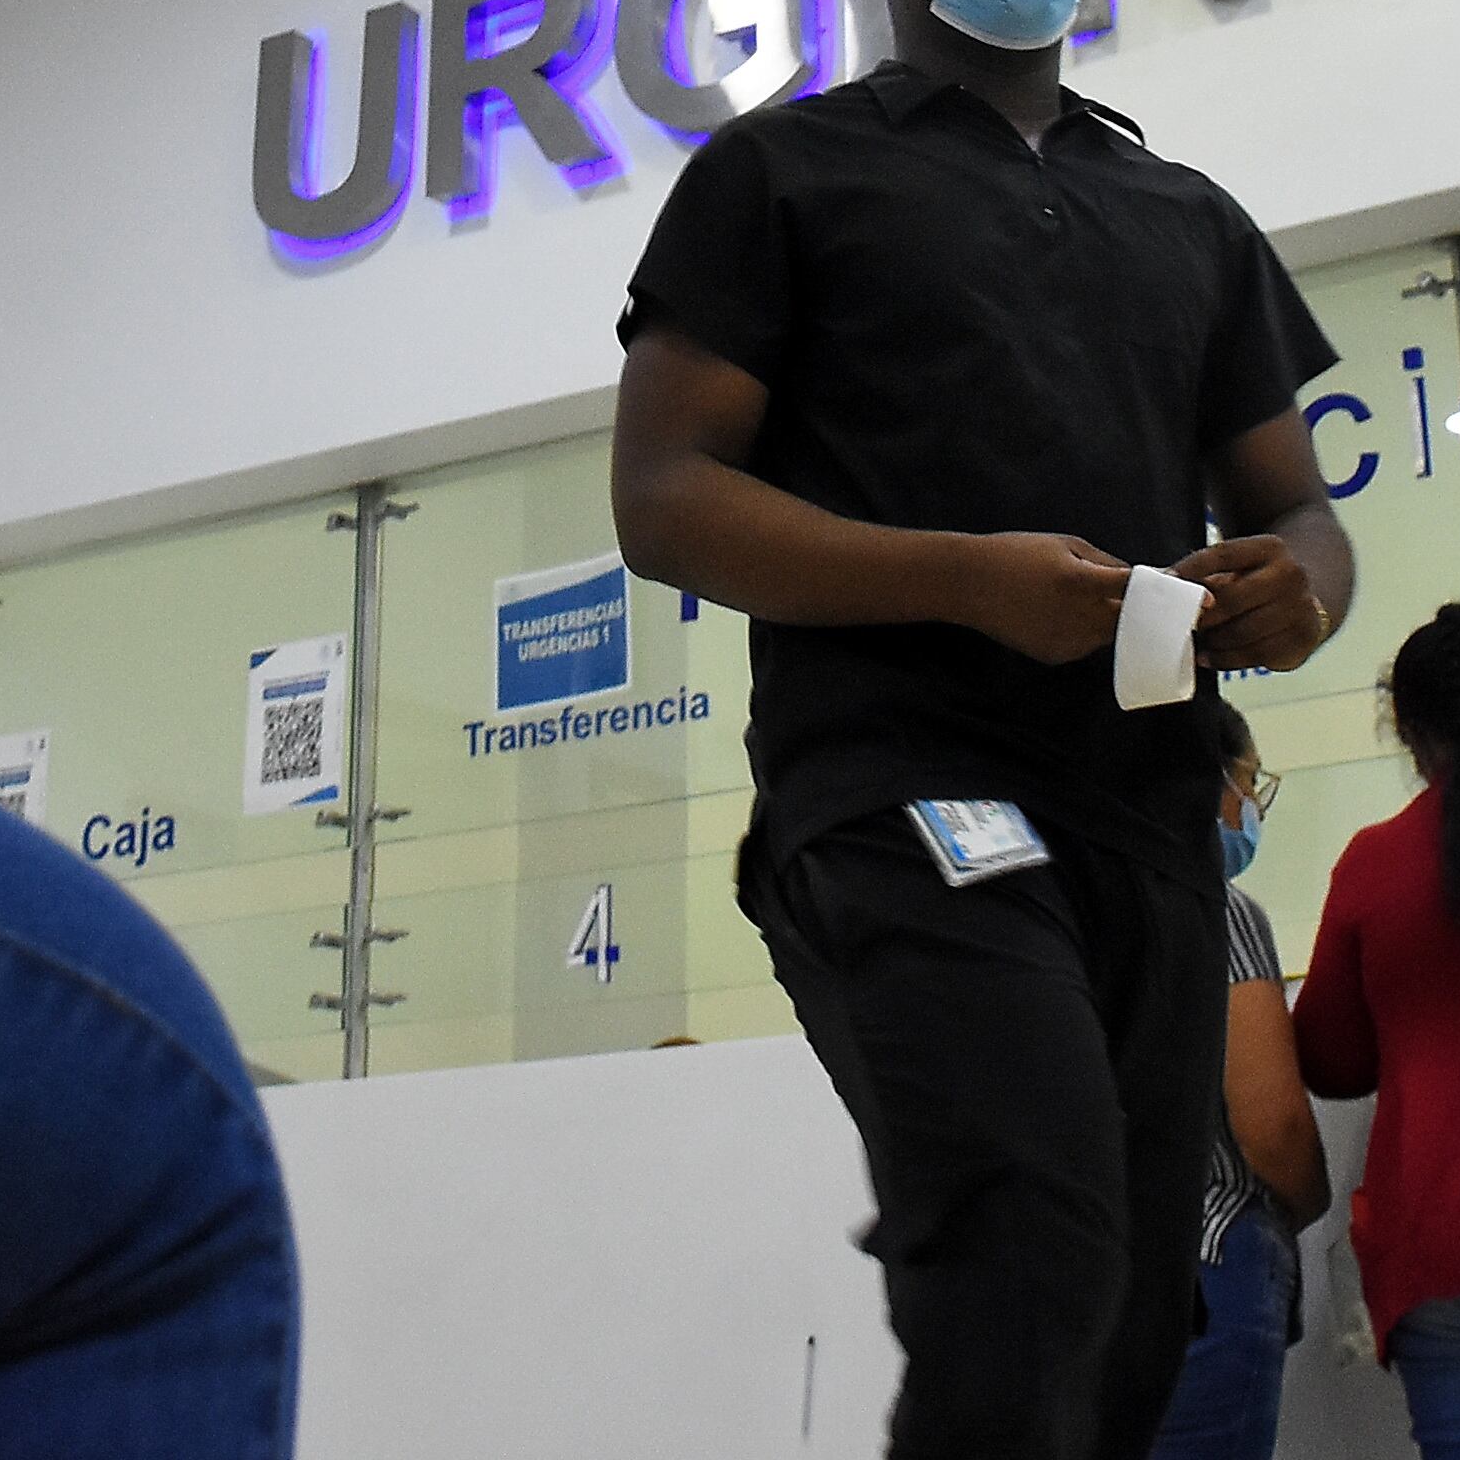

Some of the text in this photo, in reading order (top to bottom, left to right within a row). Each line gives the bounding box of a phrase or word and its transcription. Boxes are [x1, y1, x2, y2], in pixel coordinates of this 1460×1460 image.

[463, 686, 709, 758] Transferencia
[83, 806, 175, 867] Caja
[567, 884, 620, 983] 4
